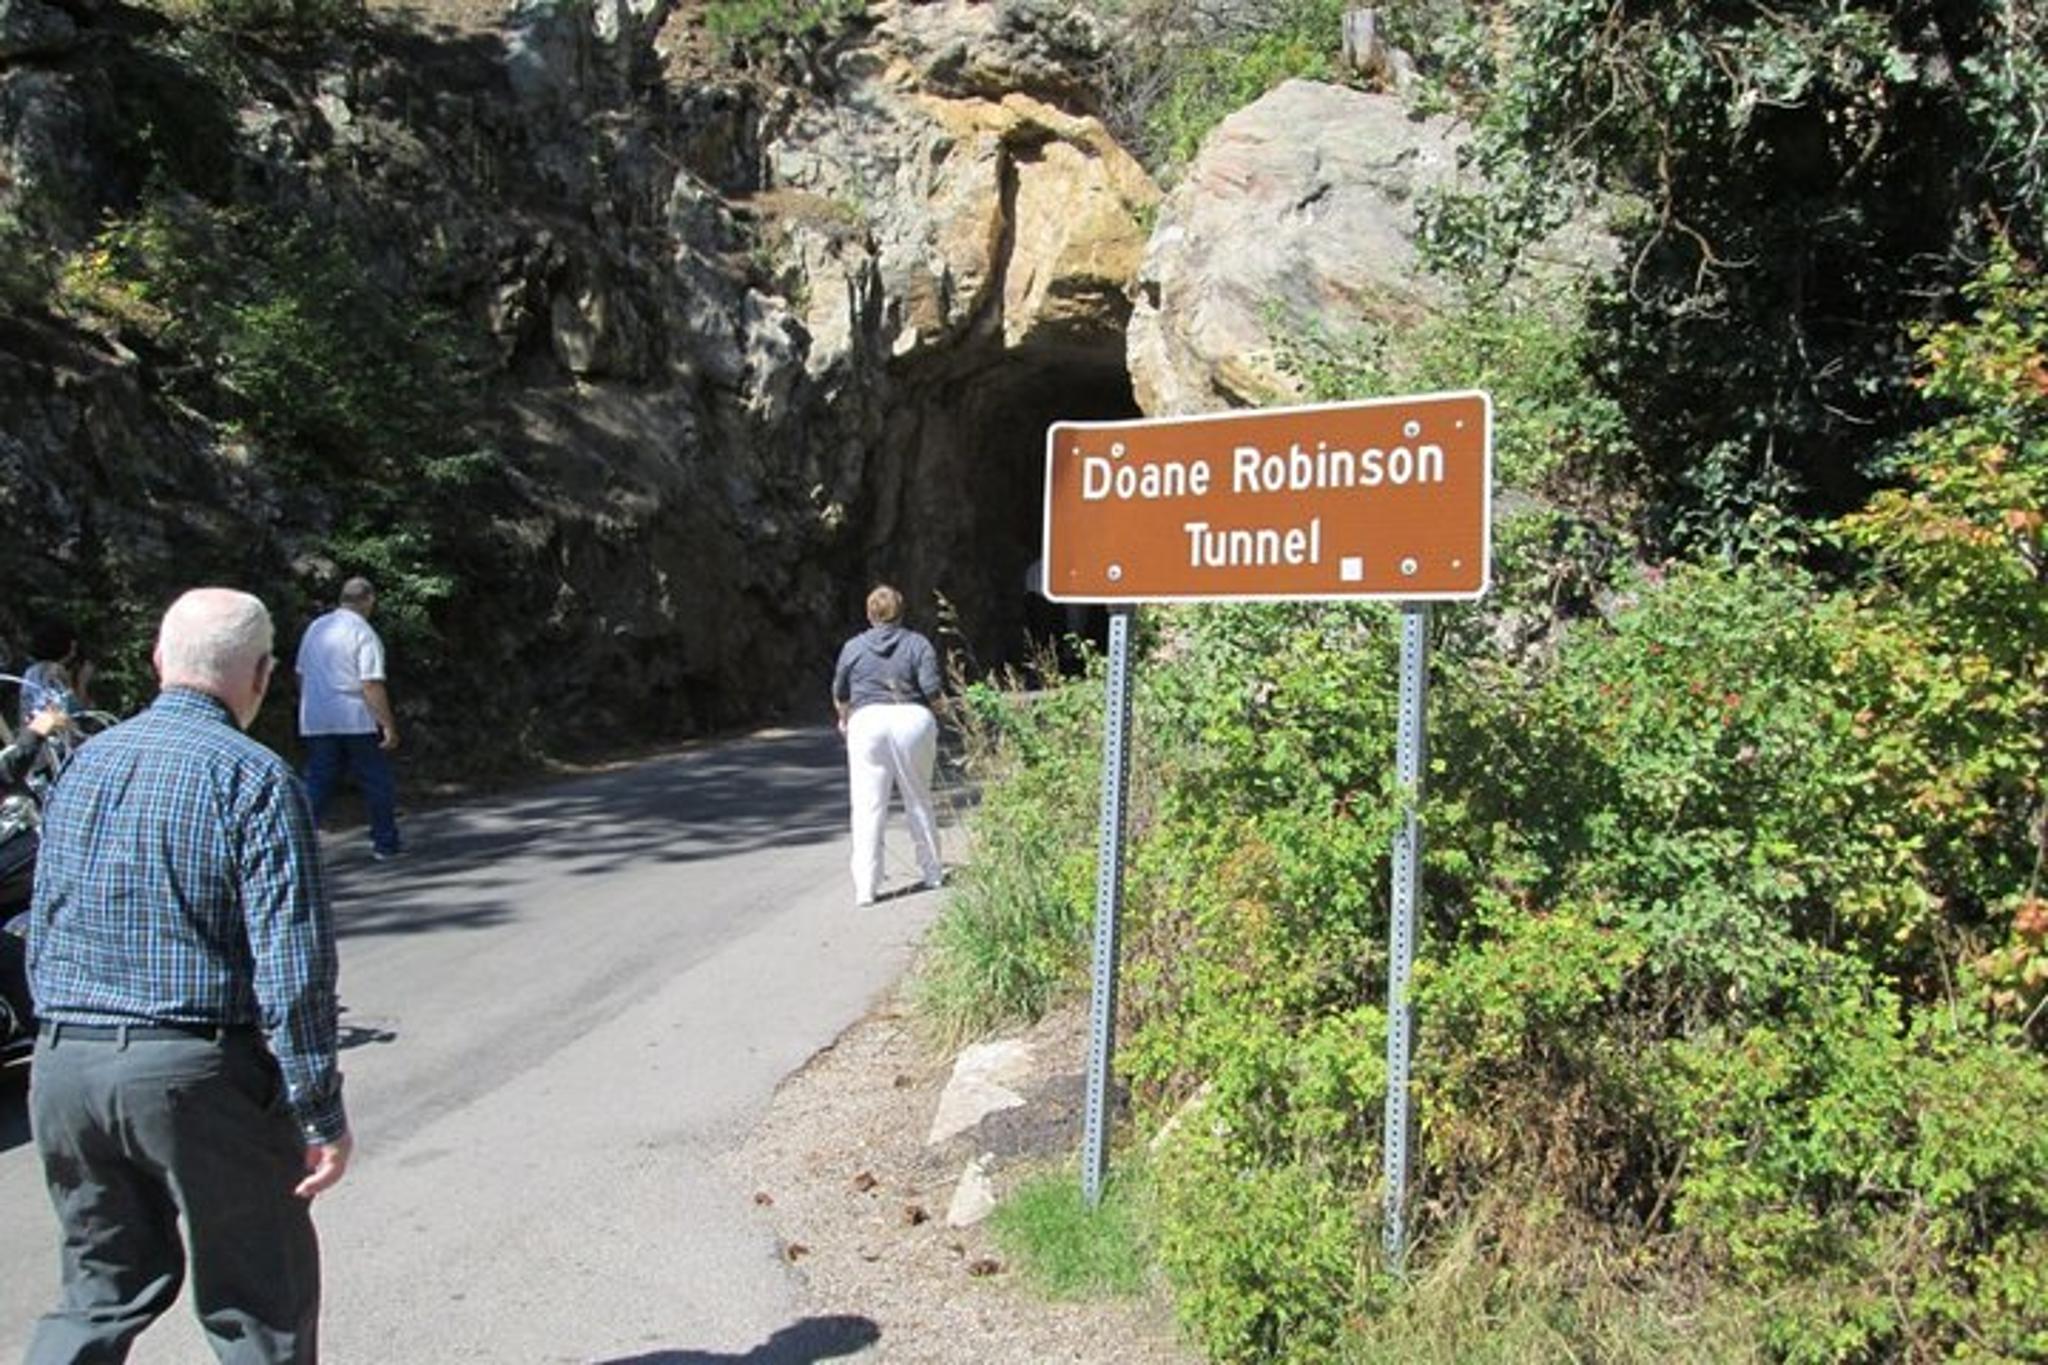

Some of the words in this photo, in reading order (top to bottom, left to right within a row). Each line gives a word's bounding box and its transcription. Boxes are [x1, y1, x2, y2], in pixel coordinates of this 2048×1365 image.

[1083, 457, 1211, 500] Doane
[1233, 442, 1444, 493] Robinson
[1185, 518, 1320, 567] Tunnel
